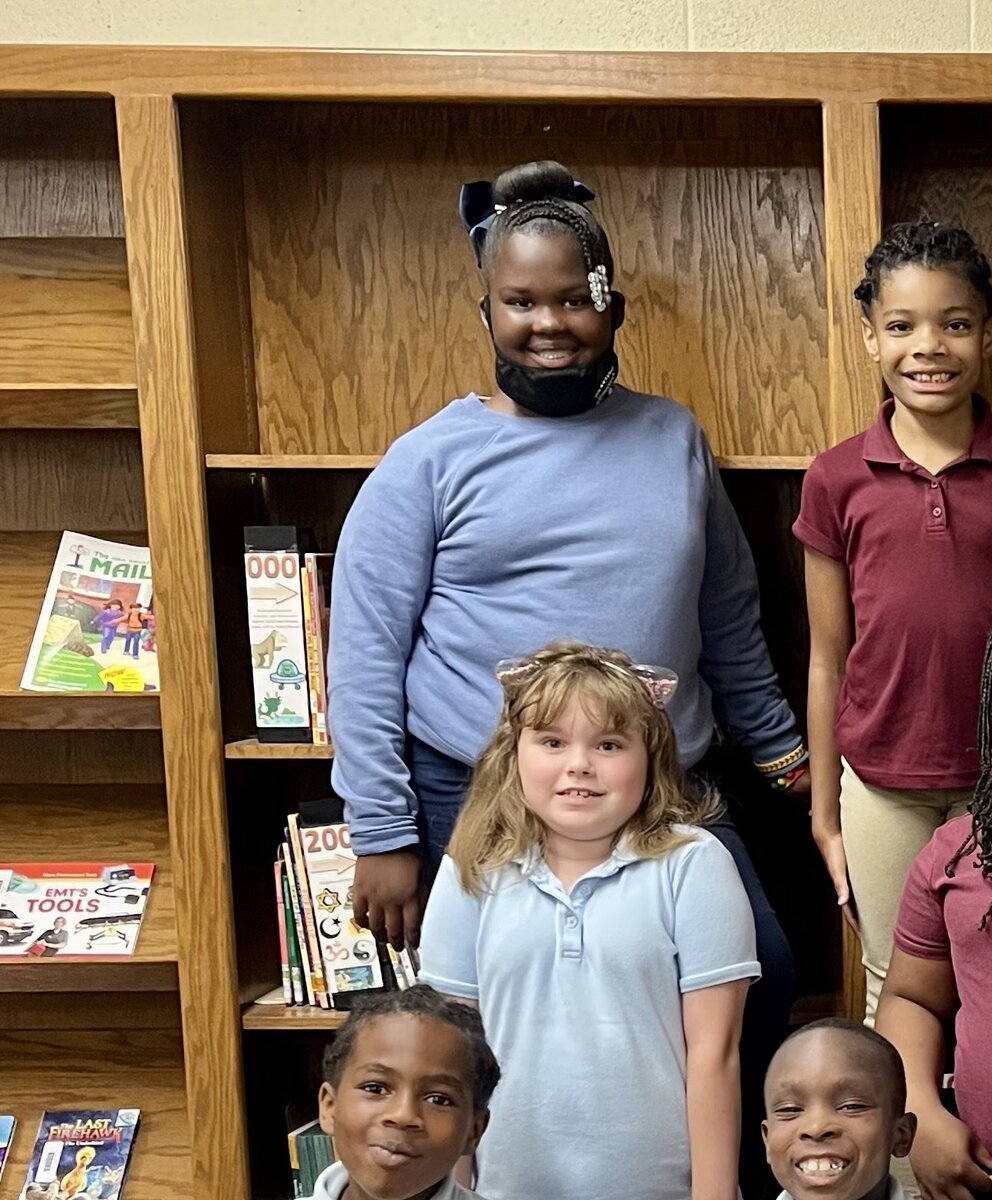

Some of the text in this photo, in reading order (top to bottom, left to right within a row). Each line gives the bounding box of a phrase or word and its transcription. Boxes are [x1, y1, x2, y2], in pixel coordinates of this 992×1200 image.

[89, 557, 152, 580] MAIL
[247, 555, 297, 579] 000
[305, 826, 352, 854] 200
[45, 888, 88, 897] EMT'S
[27, 898, 100, 913] TOOLS
[75, 1118, 111, 1130] LAST
[48, 1125, 122, 1143] FIREHAWK
